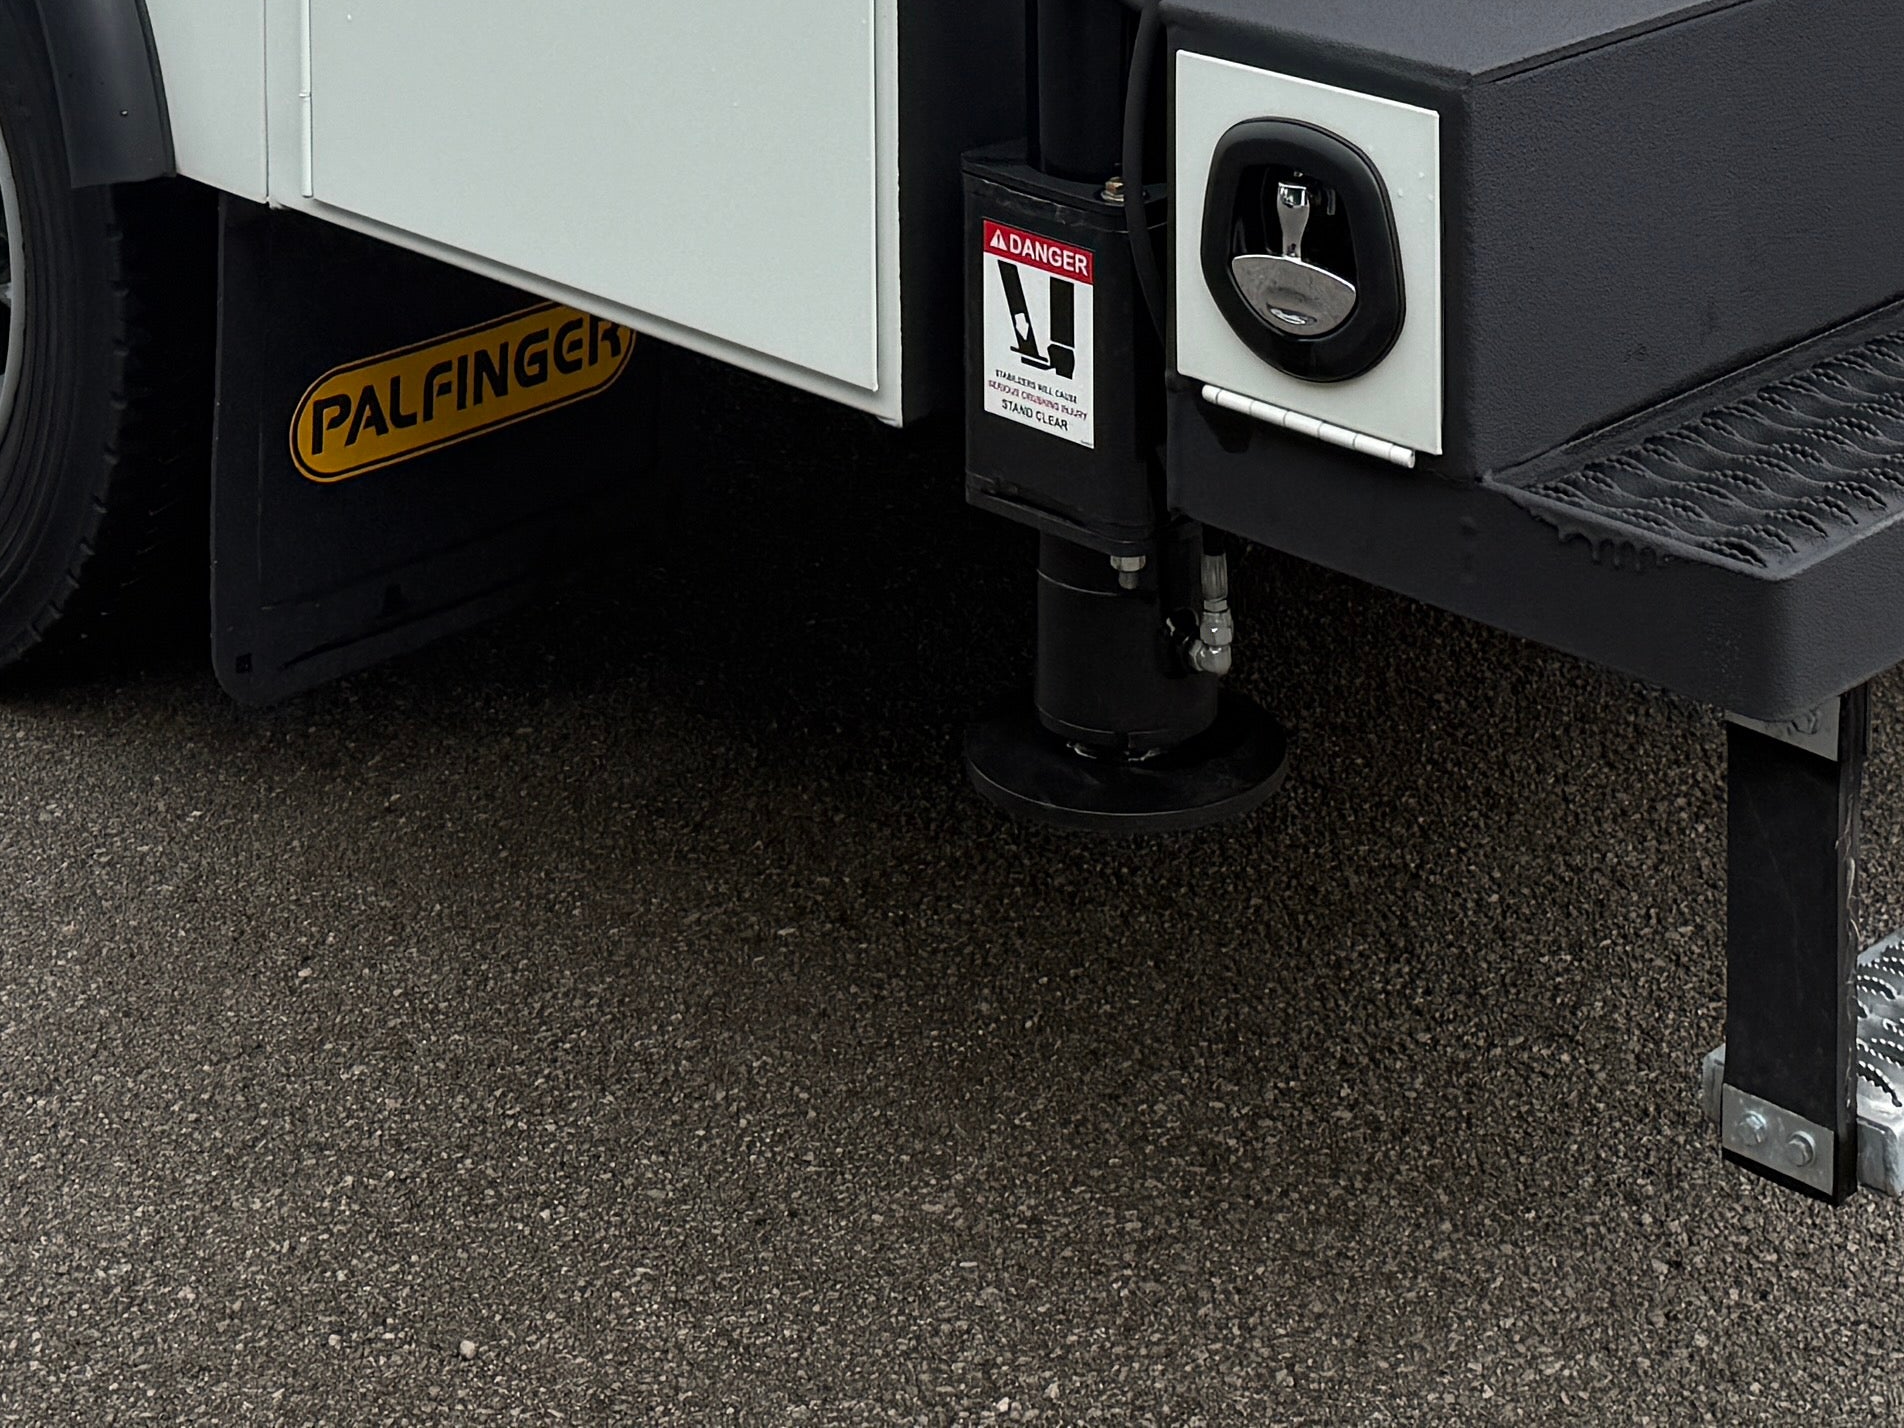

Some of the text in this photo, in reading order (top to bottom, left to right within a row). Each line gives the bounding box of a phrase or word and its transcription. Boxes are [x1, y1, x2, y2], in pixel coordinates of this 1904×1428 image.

[1009, 233, 1089, 277] DANGER
[311, 313, 623, 457] PALFINGER
[1001, 398, 1069, 432] STAND CLEAR
